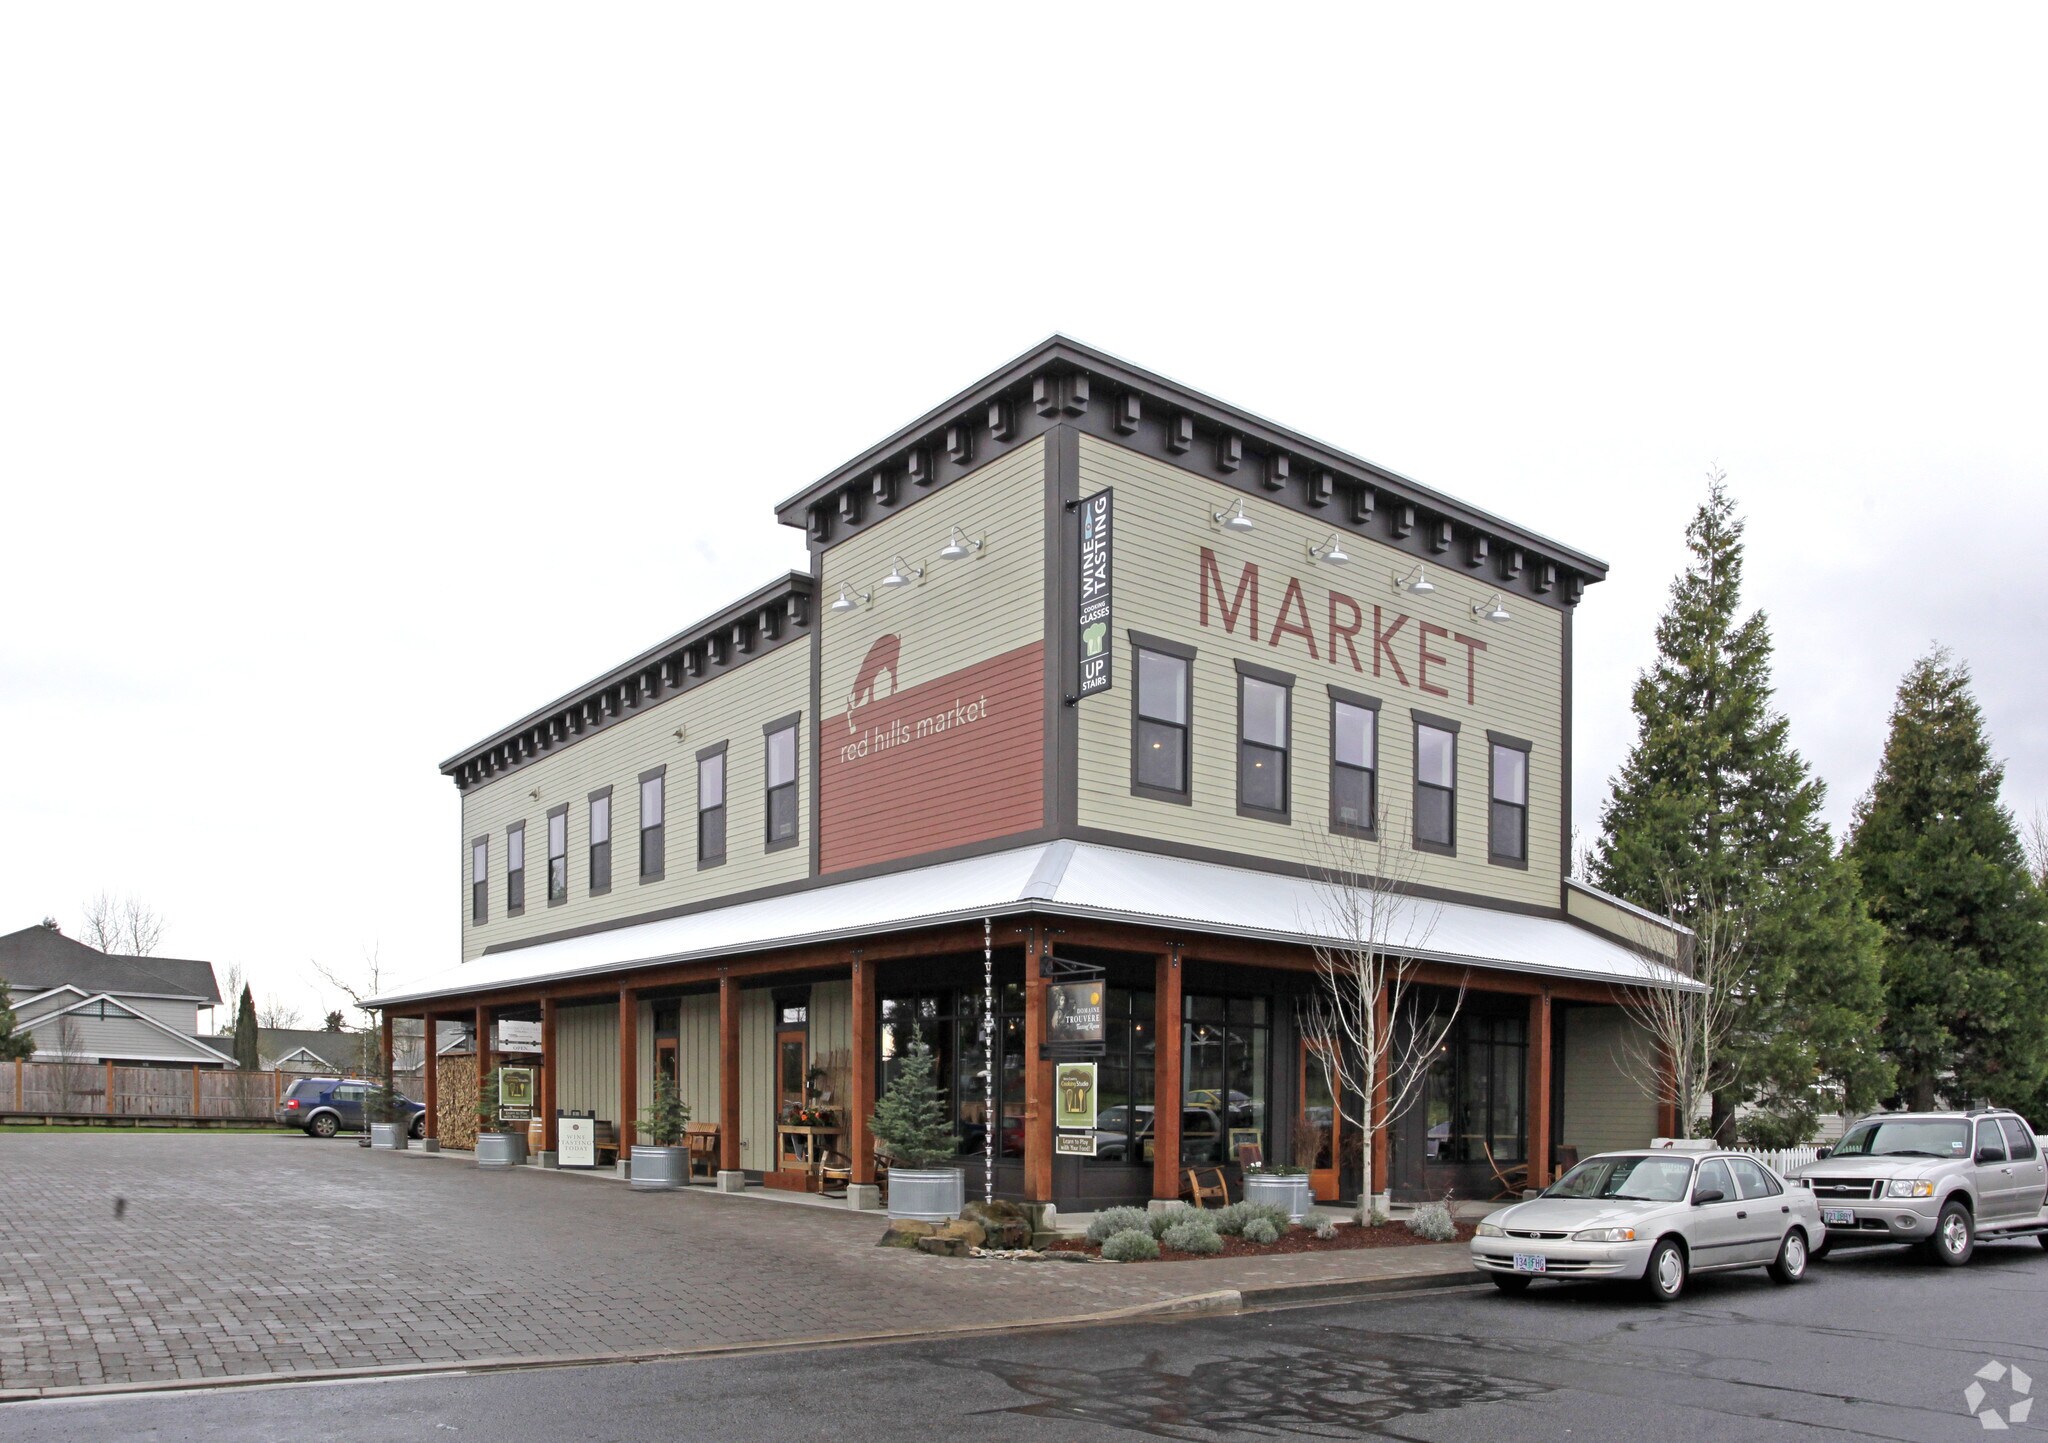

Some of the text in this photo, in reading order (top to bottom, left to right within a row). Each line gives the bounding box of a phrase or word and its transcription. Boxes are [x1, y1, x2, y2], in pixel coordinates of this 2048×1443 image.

[1094, 496, 1107, 595] TASTING
[1083, 538, 1094, 599] WINE
[1080, 606, 1110, 625] CLASSES
[1083, 601, 1106, 614] COOKING
[1200, 546, 1487, 705] MARKET
[1082, 677, 1107, 691] STAIRS
[1085, 660, 1104, 679] UP
[841, 695, 988, 763] red hills market
